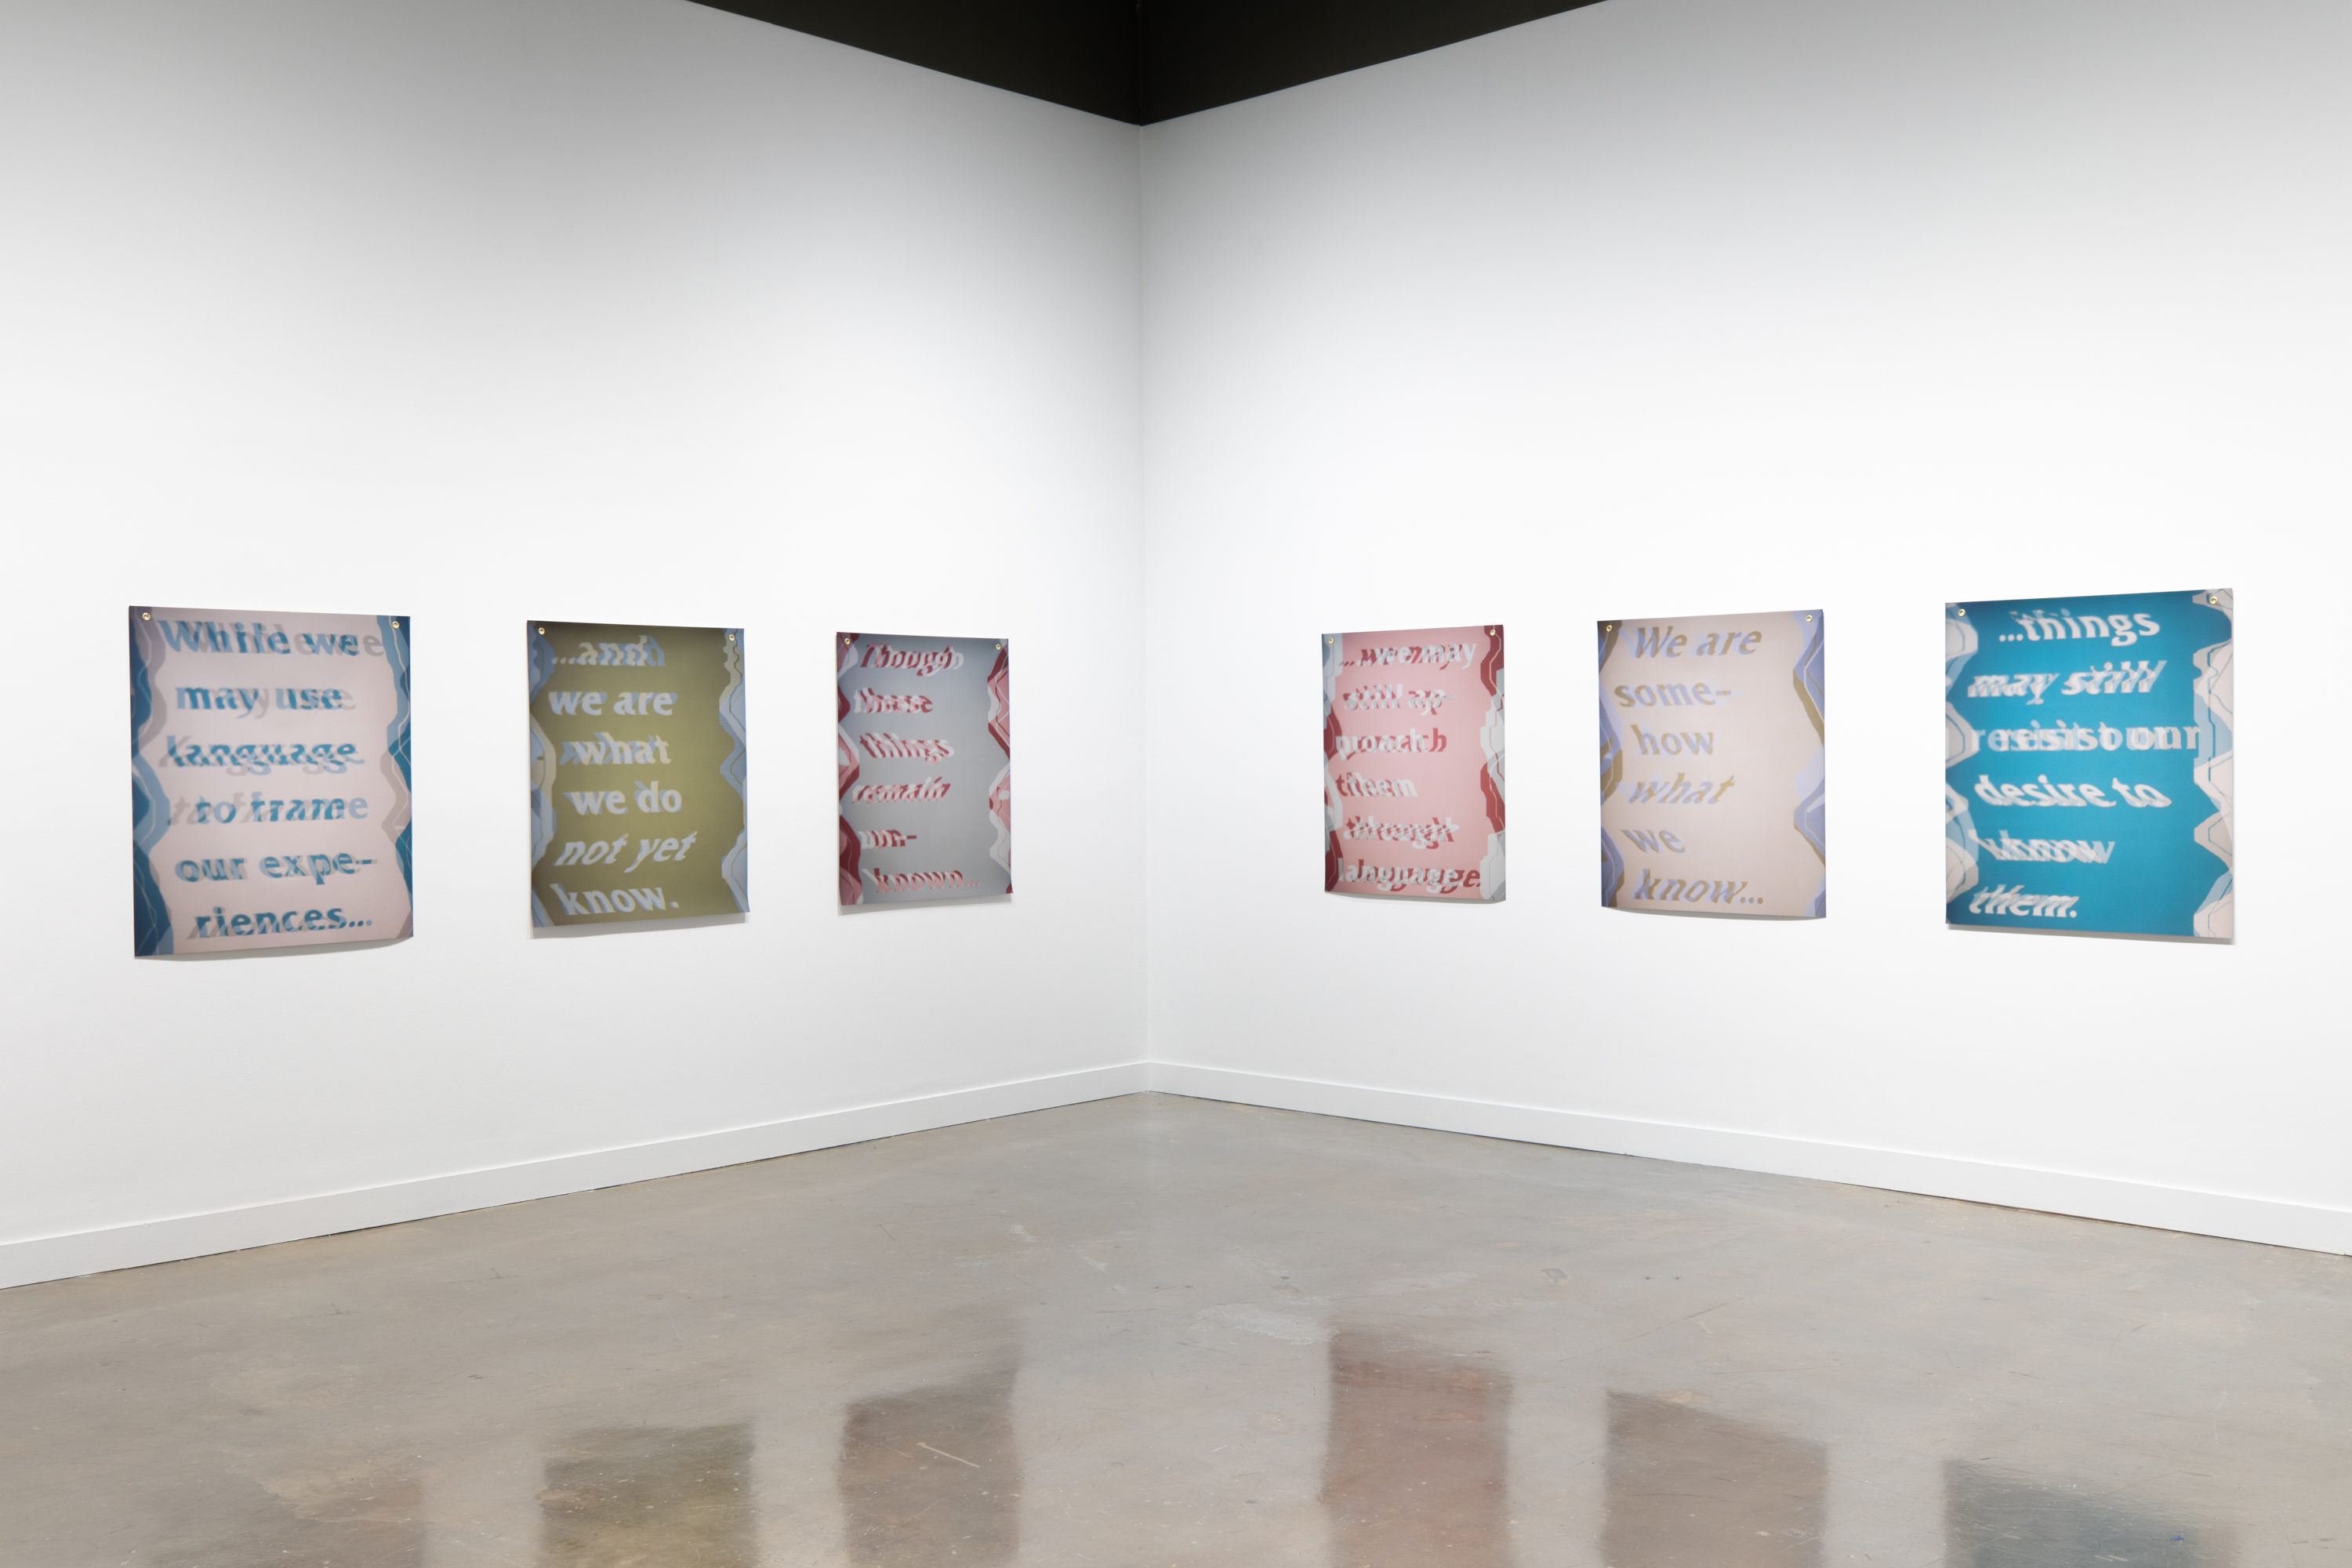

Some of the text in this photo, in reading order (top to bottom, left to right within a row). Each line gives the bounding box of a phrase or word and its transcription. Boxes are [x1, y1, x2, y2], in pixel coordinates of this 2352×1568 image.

[1617, 625, 1762, 659] We are
[1998, 608, 2161, 647] ...things
[860, 643, 964, 677] Though
[276, 687, 356, 711] use
[1613, 682, 1742, 708] some-
[1967, 659, 2168, 706] may still
[549, 691, 678, 716] we are
[158, 735, 365, 776] language
[559, 731, 672, 766] what
[860, 732, 955, 765] things
[1630, 723, 1717, 757] how
[562, 780, 683, 815] we do
[852, 776, 951, 804] remain
[1617, 772, 1735, 805] what
[1974, 774, 2172, 809] desire to
[553, 831, 698, 873] not yet
[1621, 829, 1690, 855] we
[175, 851, 378, 885] our expe-
[862, 867, 981, 893] known...
[550, 883, 679, 915] know.
[1629, 868, 1764, 906] know...
[1968, 883, 2080, 918] them.
[187, 906, 372, 939] riences...
